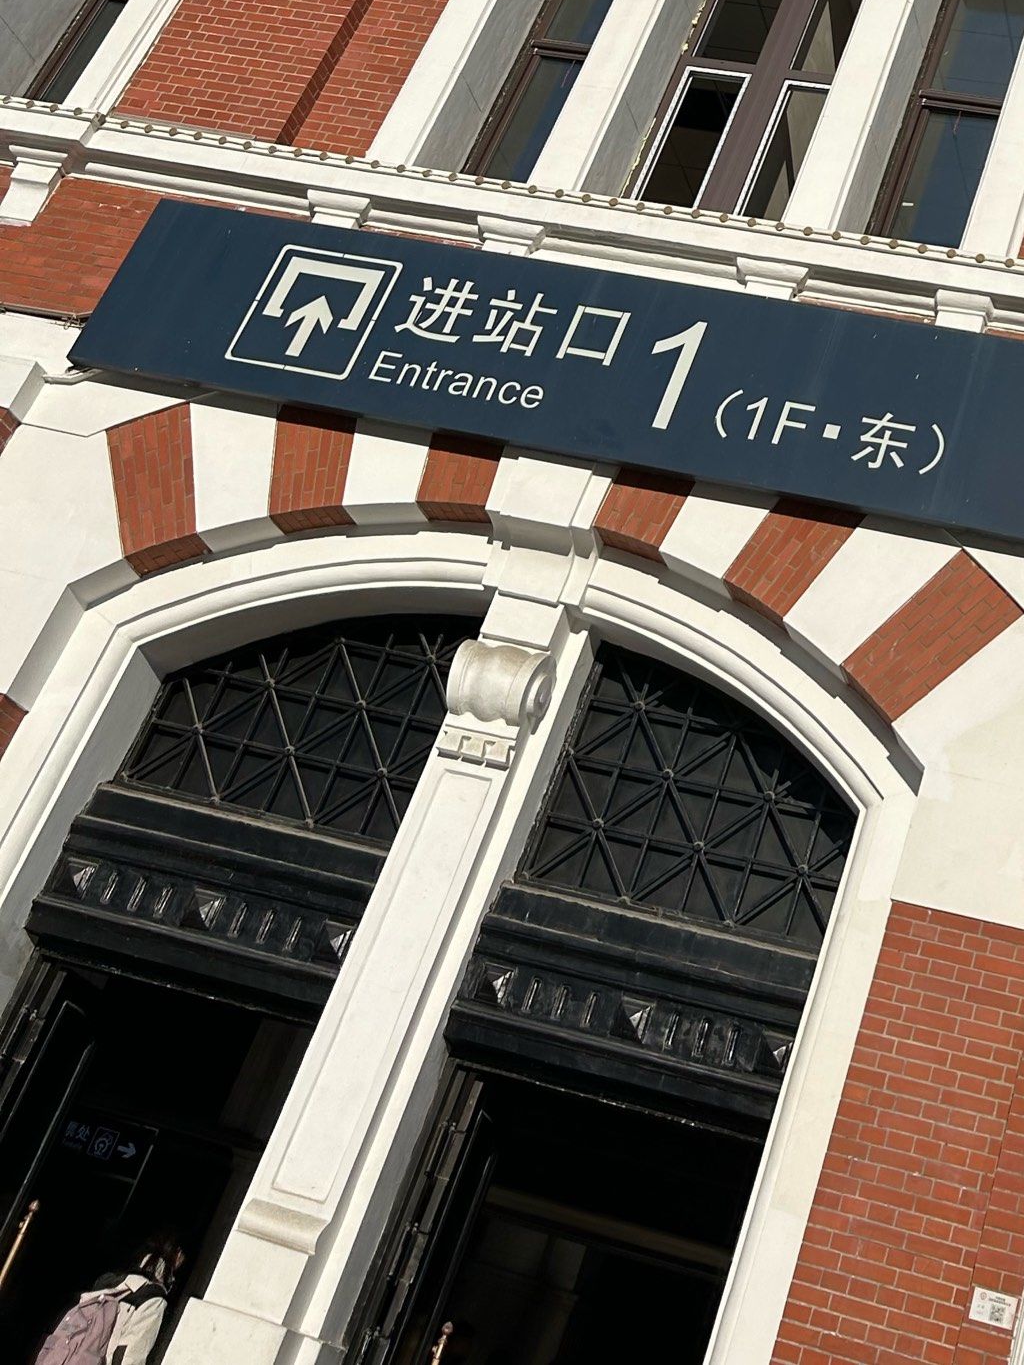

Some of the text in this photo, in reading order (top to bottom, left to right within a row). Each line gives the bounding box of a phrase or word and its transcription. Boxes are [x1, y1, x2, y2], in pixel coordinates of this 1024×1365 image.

[368, 350, 544, 409] Entrance
[394, 276, 631, 366] 进站口
[651, 321, 708, 430] 1
